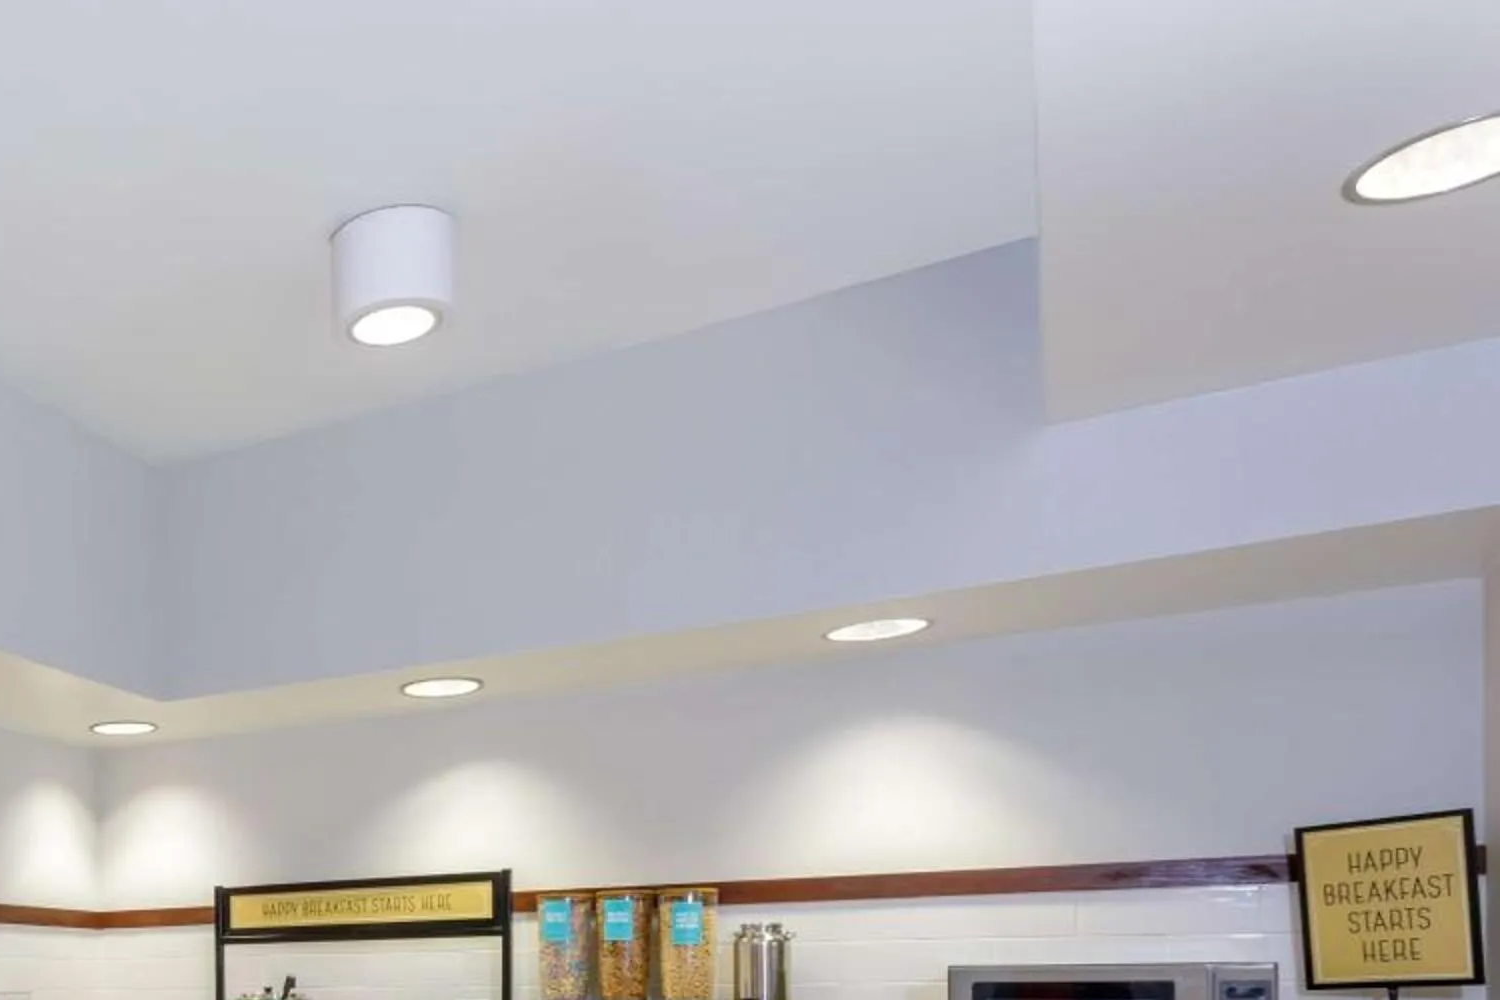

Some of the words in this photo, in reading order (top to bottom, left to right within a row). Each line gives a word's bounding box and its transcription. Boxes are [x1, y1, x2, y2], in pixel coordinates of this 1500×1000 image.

[1347, 846, 1424, 874] HAPPY
[1322, 873, 1454, 907] BREAKFAST
[261, 900, 299, 918] HAPPY
[301, 897, 368, 917] BREAKFAST
[371, 894, 416, 914] STARTS
[421, 892, 453, 912] HERE
[1347, 906, 1432, 934] STARTS
[1362, 937, 1423, 963] HERE
